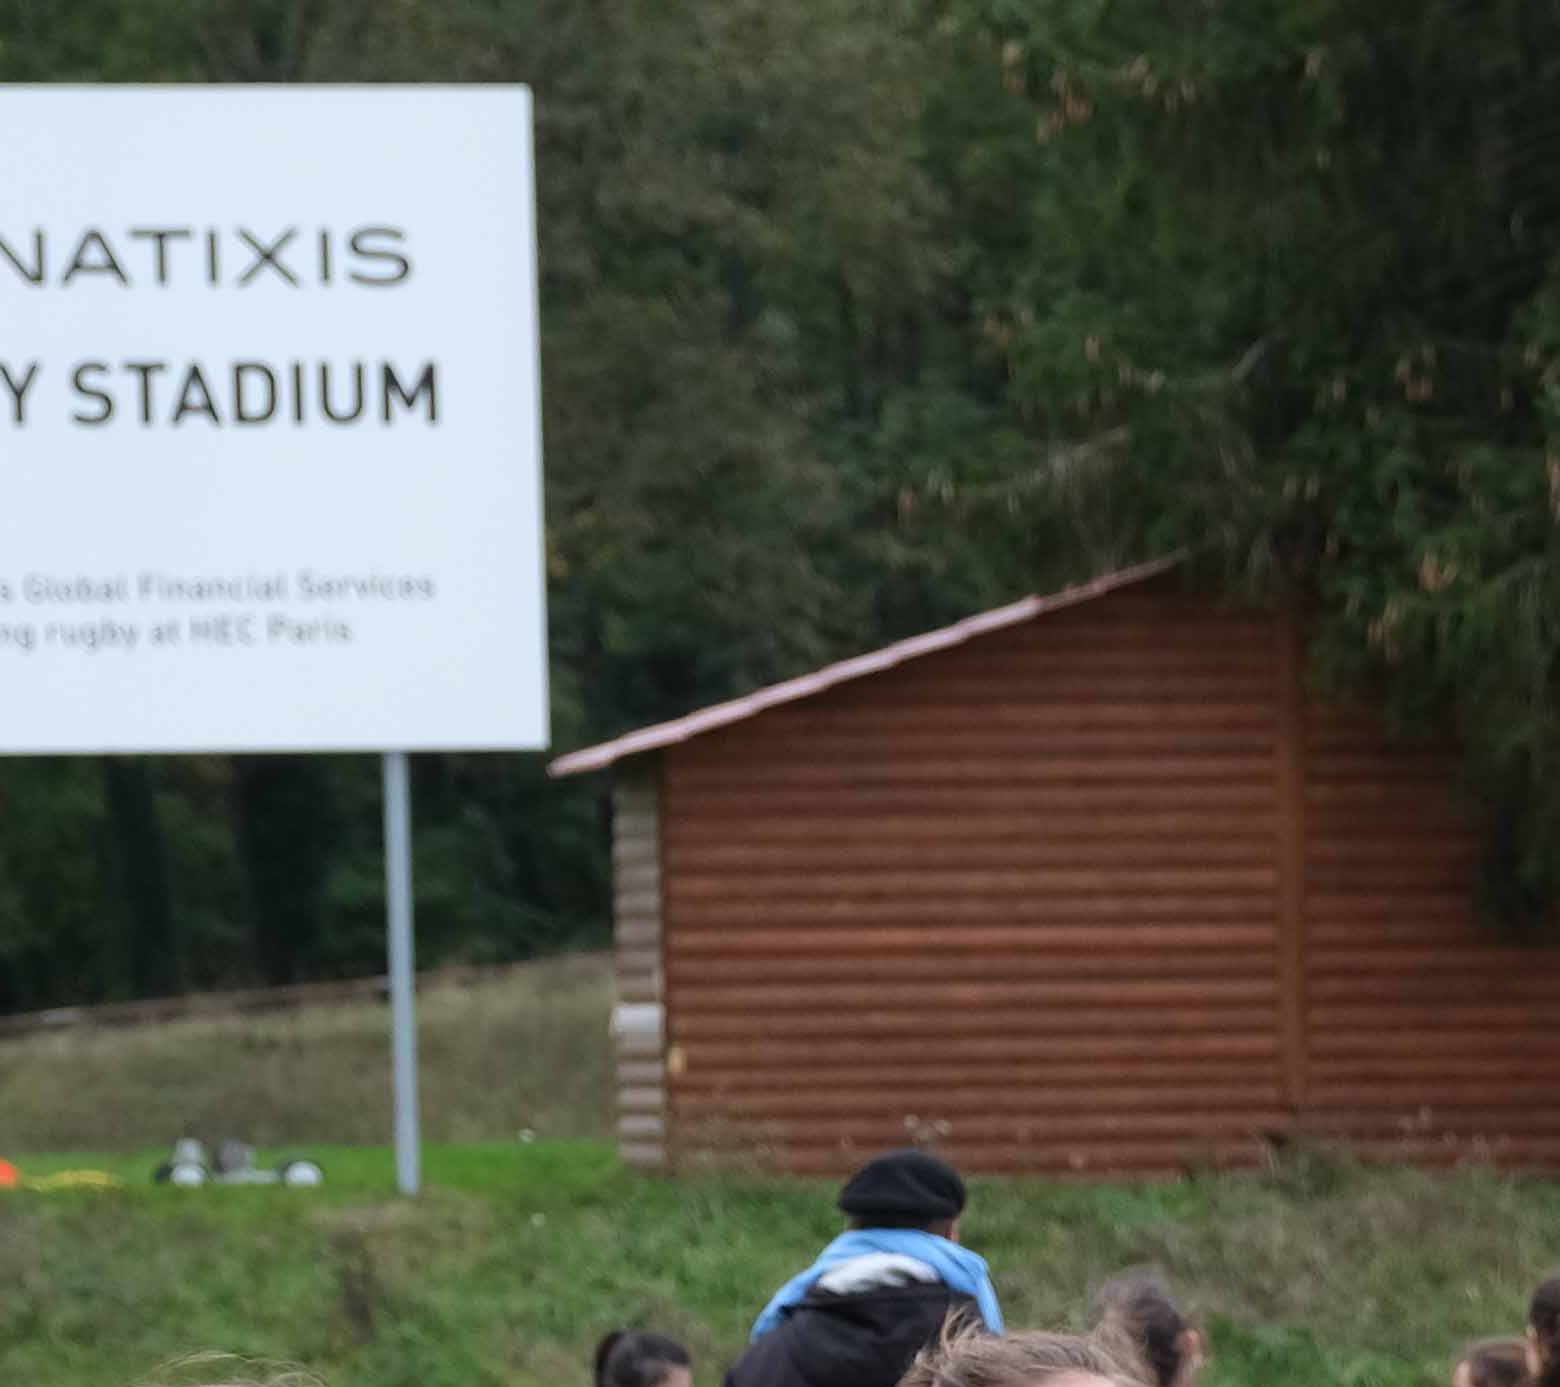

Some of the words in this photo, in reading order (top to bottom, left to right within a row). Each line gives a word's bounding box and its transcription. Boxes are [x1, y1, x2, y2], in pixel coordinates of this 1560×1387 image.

[70, 358, 441, 430] STADIUM
[21, 571, 129, 607] Global
[137, 570, 288, 606] Financial
[296, 569, 437, 605] Services
[44, 615, 138, 652] rugby
[149, 617, 182, 645] at
[188, 615, 257, 645] HEC
[266, 615, 352, 645] Paris
